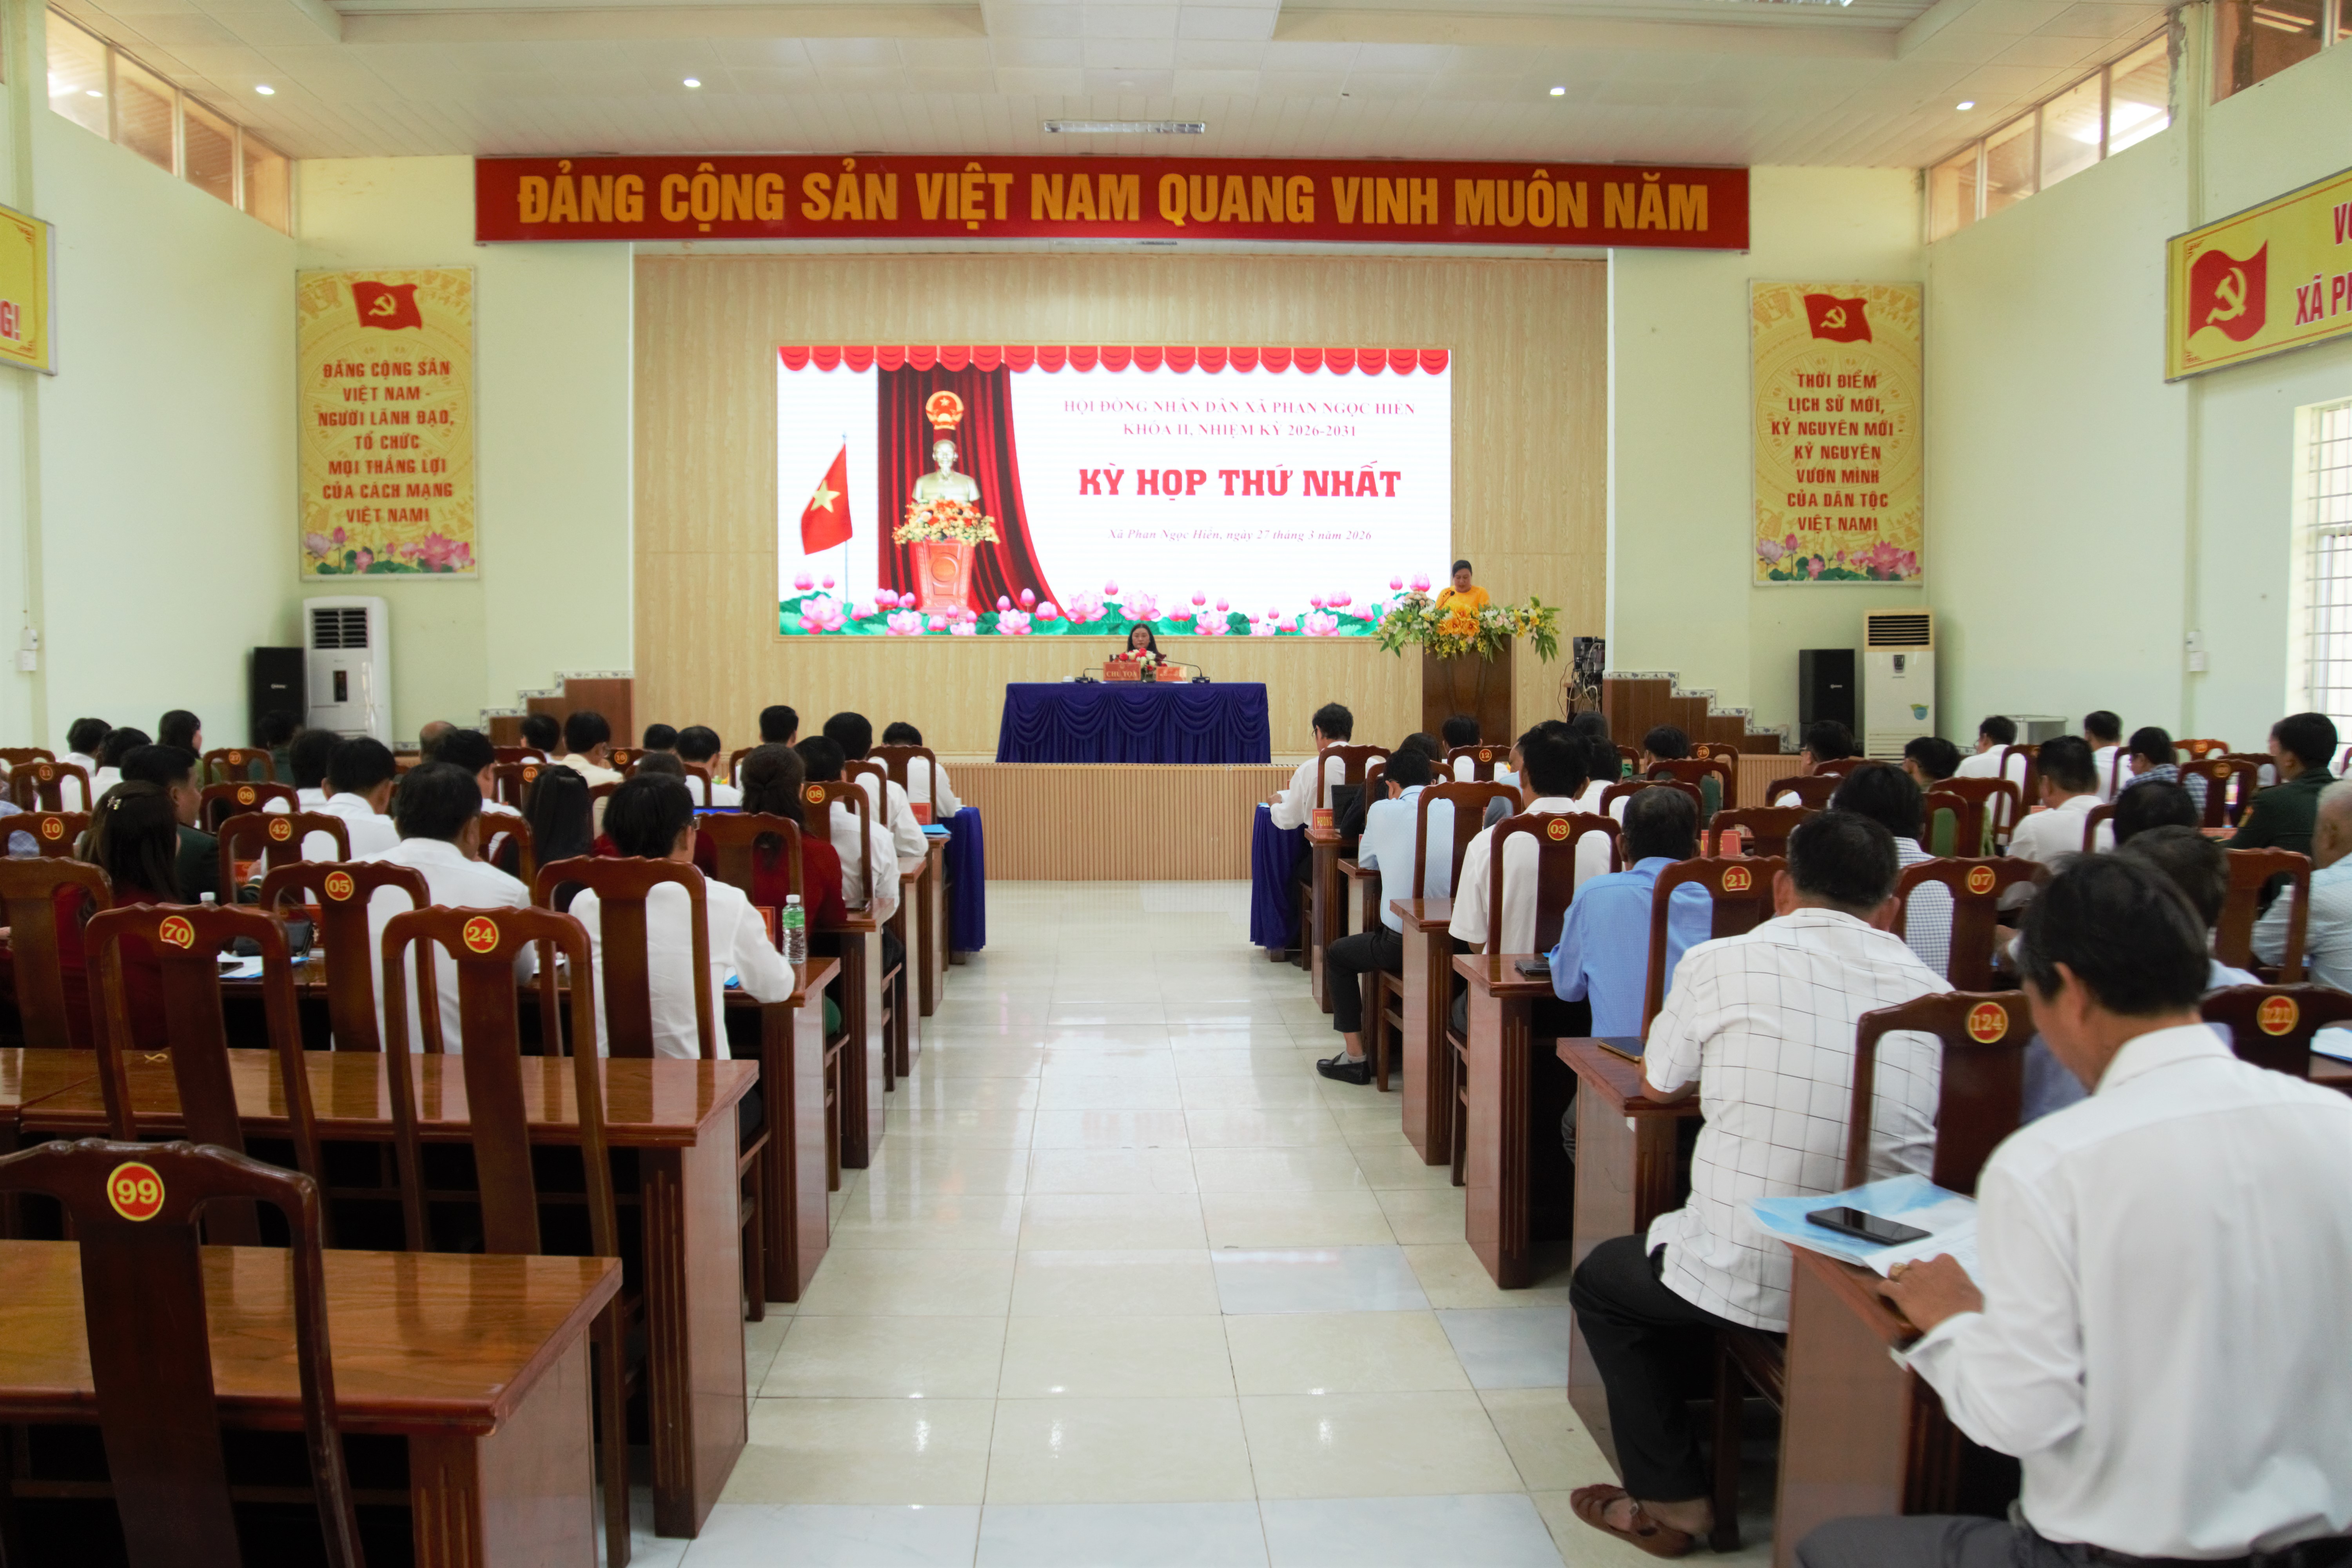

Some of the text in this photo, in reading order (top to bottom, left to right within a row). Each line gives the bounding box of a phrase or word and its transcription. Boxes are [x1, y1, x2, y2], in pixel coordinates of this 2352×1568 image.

[518, 158, 1708, 232] ĐẢNG CỘNG SẢN VIỆT NAM QUANG VINH MUÔN NĂM
[2295, 272, 2324, 327] XÃ
[323, 358, 450, 379] ĐẢNG CỘNG SẢN
[1797, 369, 1877, 388] THỜI ĐIỂM
[343, 385, 378, 405] VIỆT
[385, 387, 419, 401] NAM
[1789, 394, 1884, 414] LỊCH SỬ MỚI,
[1154, 398, 1199, 412] NHÂN
[1206, 398, 1238, 412] DÂN
[1245, 399, 1267, 413] XÃ
[1273, 401, 1316, 413] PHAN
[1323, 401, 1370, 417] NGỌC
[318, 408, 454, 427] NGƯỜI LÃNH ĐẠO,
[1771, 417, 1791, 435] KỶ
[1798, 419, 1858, 436] NGUYÊN
[1864, 420, 1893, 436] MỚI
[1124, 420, 1171, 435] KHÓA
[1199, 422, 1253, 438] NHIỆM
[1260, 421, 1281, 436] KỲ
[1288, 424, 1356, 436] 2026-2031
[354, 431, 419, 450] TỔ CHỨC
[1794, 441, 1881, 459] KỶ NGUYÊN
[328, 454, 446, 477] MỌI THẮNG LỢI
[1797, 467, 1879, 483] VƯƠN MÌNH
[1079, 460, 1401, 501] KỲ HỌP THỨ NHẤT
[323, 481, 452, 500] CỦA CÁCH MẠNG
[1788, 489, 1888, 510] CỦA DÂN TỘC
[346, 506, 381, 526] VIỆT
[1798, 514, 1878, 534] VIỆT NAM!
[1108, 529, 1123, 539] Xã
[1127, 529, 1156, 539] Phan
[1161, 529, 1189, 541] Ngọc
[1227, 530, 1253, 541] ngày
[1257, 530, 1270, 539] 27
[1273, 530, 1305, 542] tháng
[1308, 530, 1314, 540] 3
[1318, 531, 1341, 540] năm
[1346, 530, 1371, 540] 2026
[809, 789, 822, 799] 08
[46, 824, 60, 833] 10
[272, 824, 288, 834] 42
[1550, 824, 1567, 835] 03
[328, 880, 350, 893] 05
[1726, 874, 1747, 887] 21
[1971, 874, 1992, 885] 07
[164, 923, 189, 944] 70
[467, 927, 494, 943] 24
[1973, 1014, 2003, 1031] 124
[116, 1179, 157, 1204] 99
